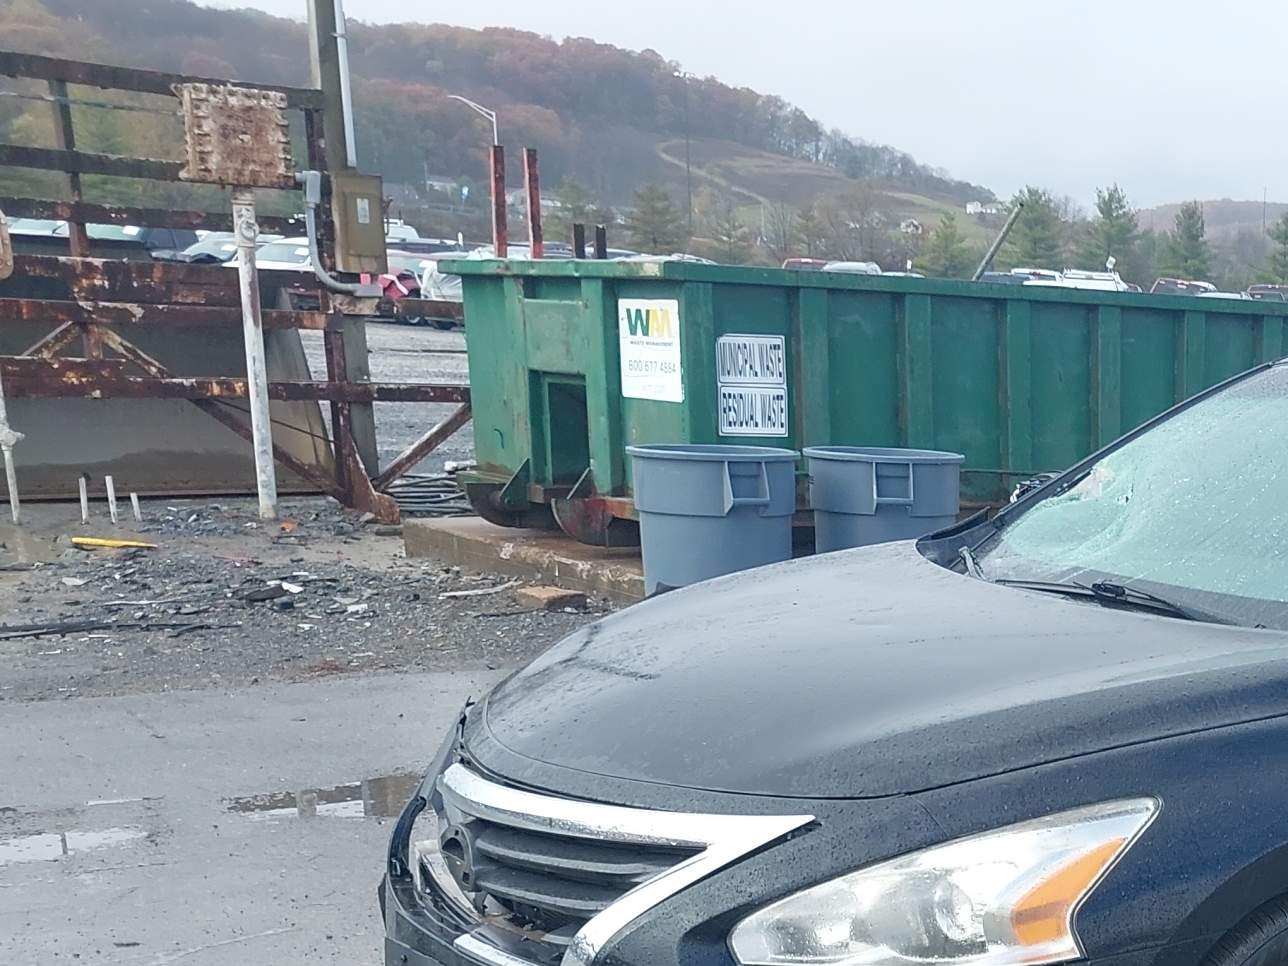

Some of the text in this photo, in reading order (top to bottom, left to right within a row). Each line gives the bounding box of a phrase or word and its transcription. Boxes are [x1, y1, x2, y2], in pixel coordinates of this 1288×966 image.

[626, 308, 673, 338] WM
[719, 342, 783, 378] MUNICIPAL WASTE
[722, 393, 784, 428] RESIDUAL WASTE
